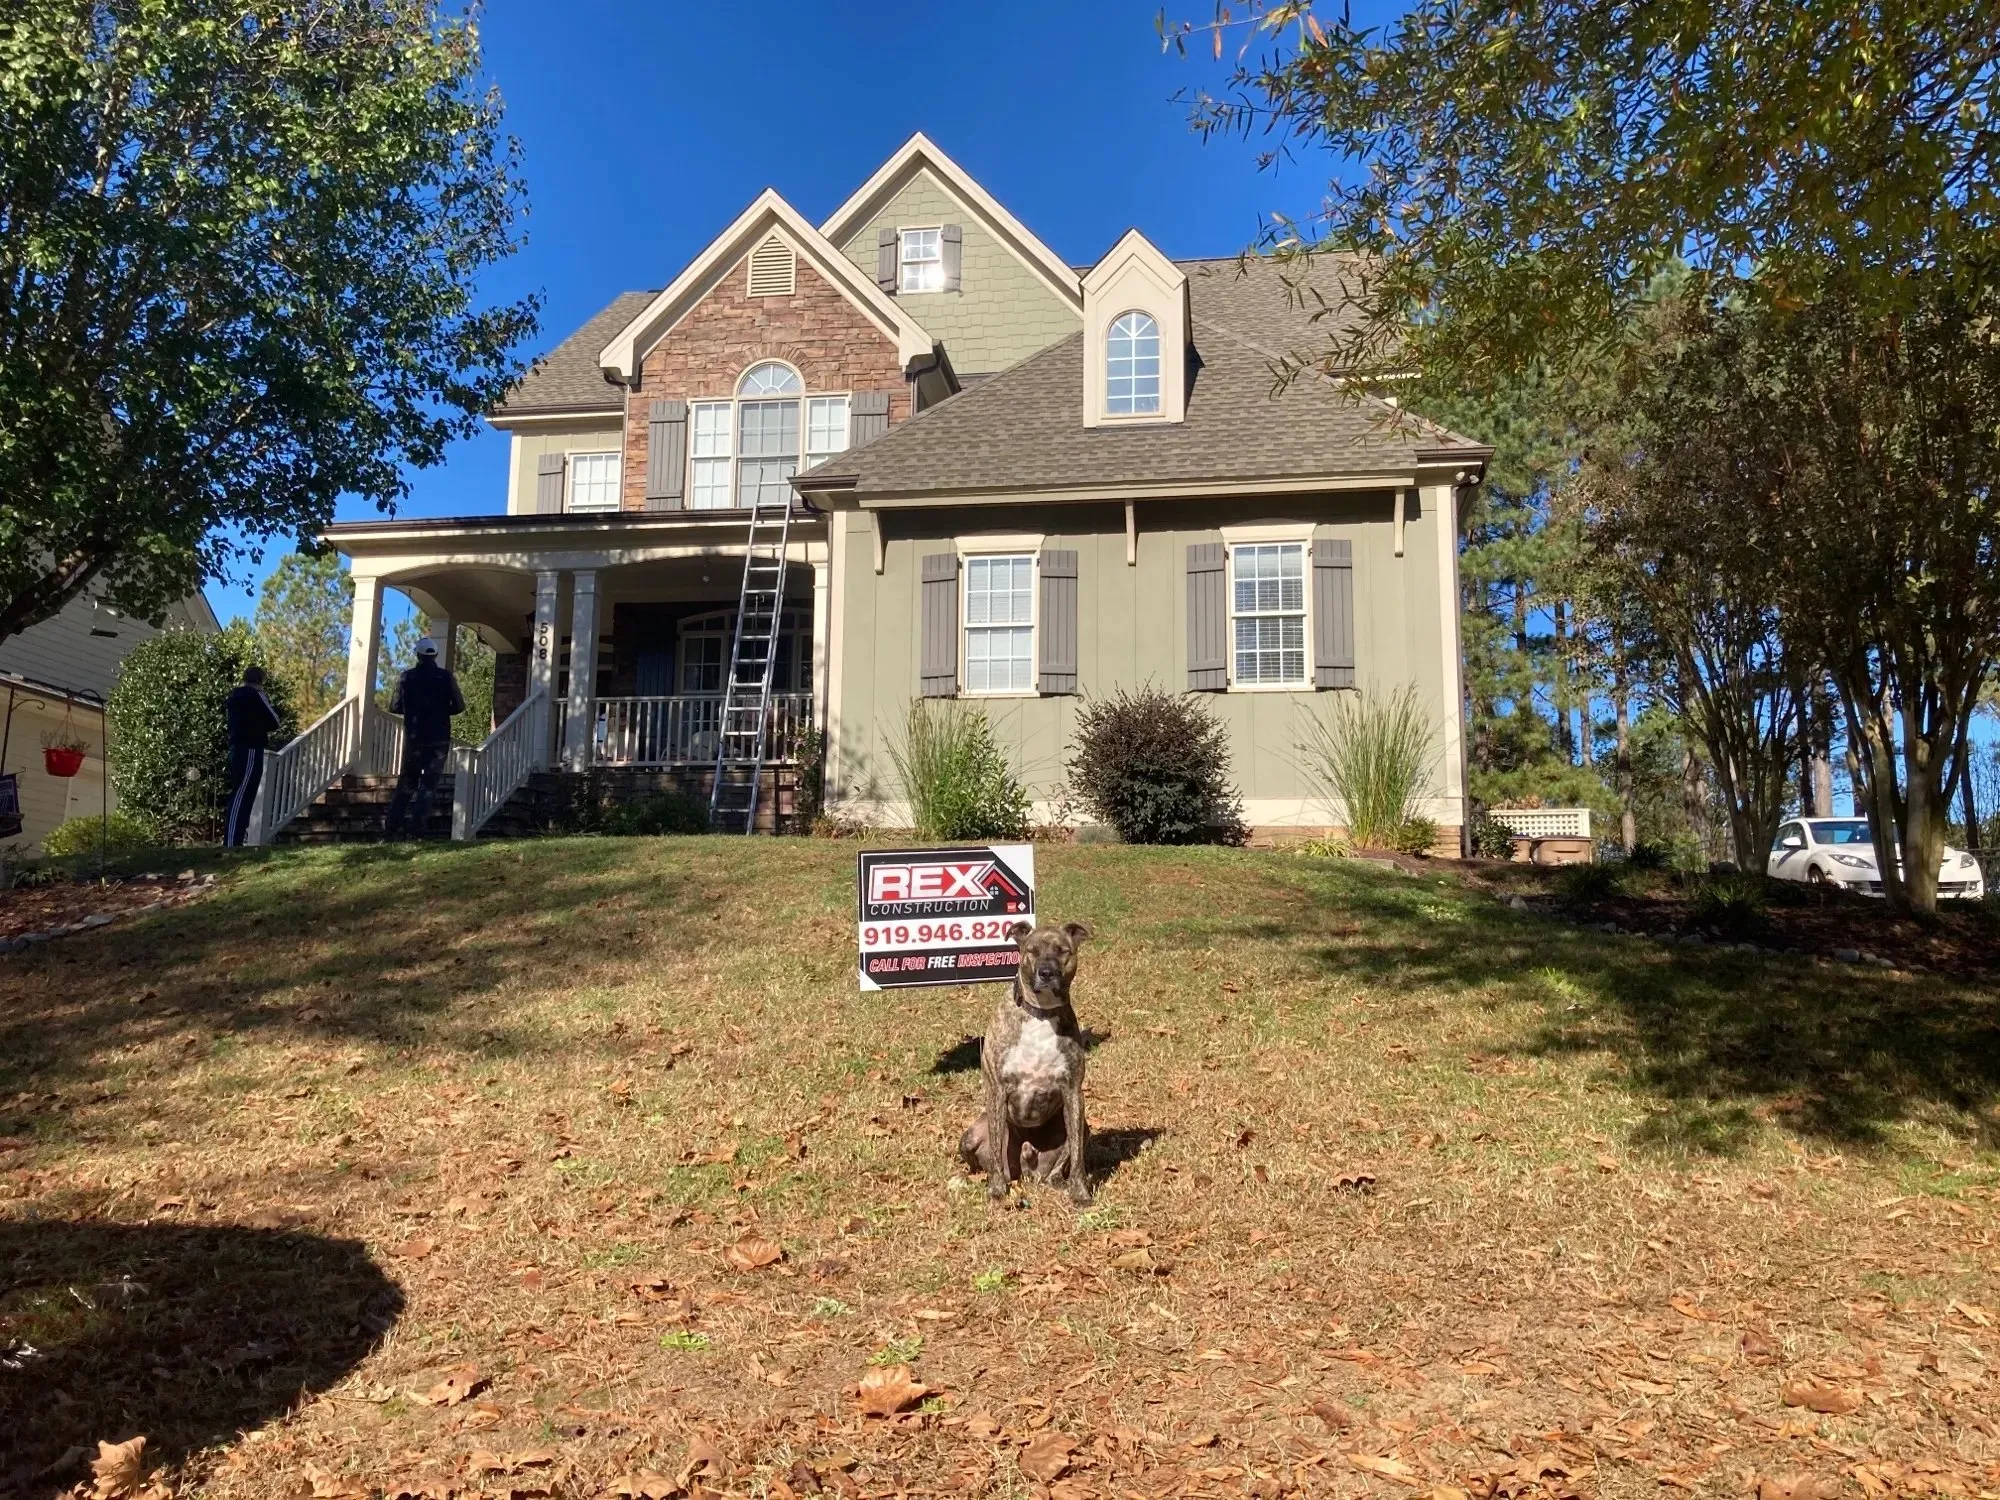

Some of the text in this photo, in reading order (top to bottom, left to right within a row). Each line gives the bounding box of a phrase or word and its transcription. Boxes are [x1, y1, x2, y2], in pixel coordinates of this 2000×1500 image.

[539, 623, 548, 660] 508
[871, 863, 986, 900] REX
[870, 900, 990, 916] CONSTRUCTION
[864, 920, 1015, 946] 919.946.820
[869, 951, 1022, 972] CALL FOR FREE INSPECTIO
